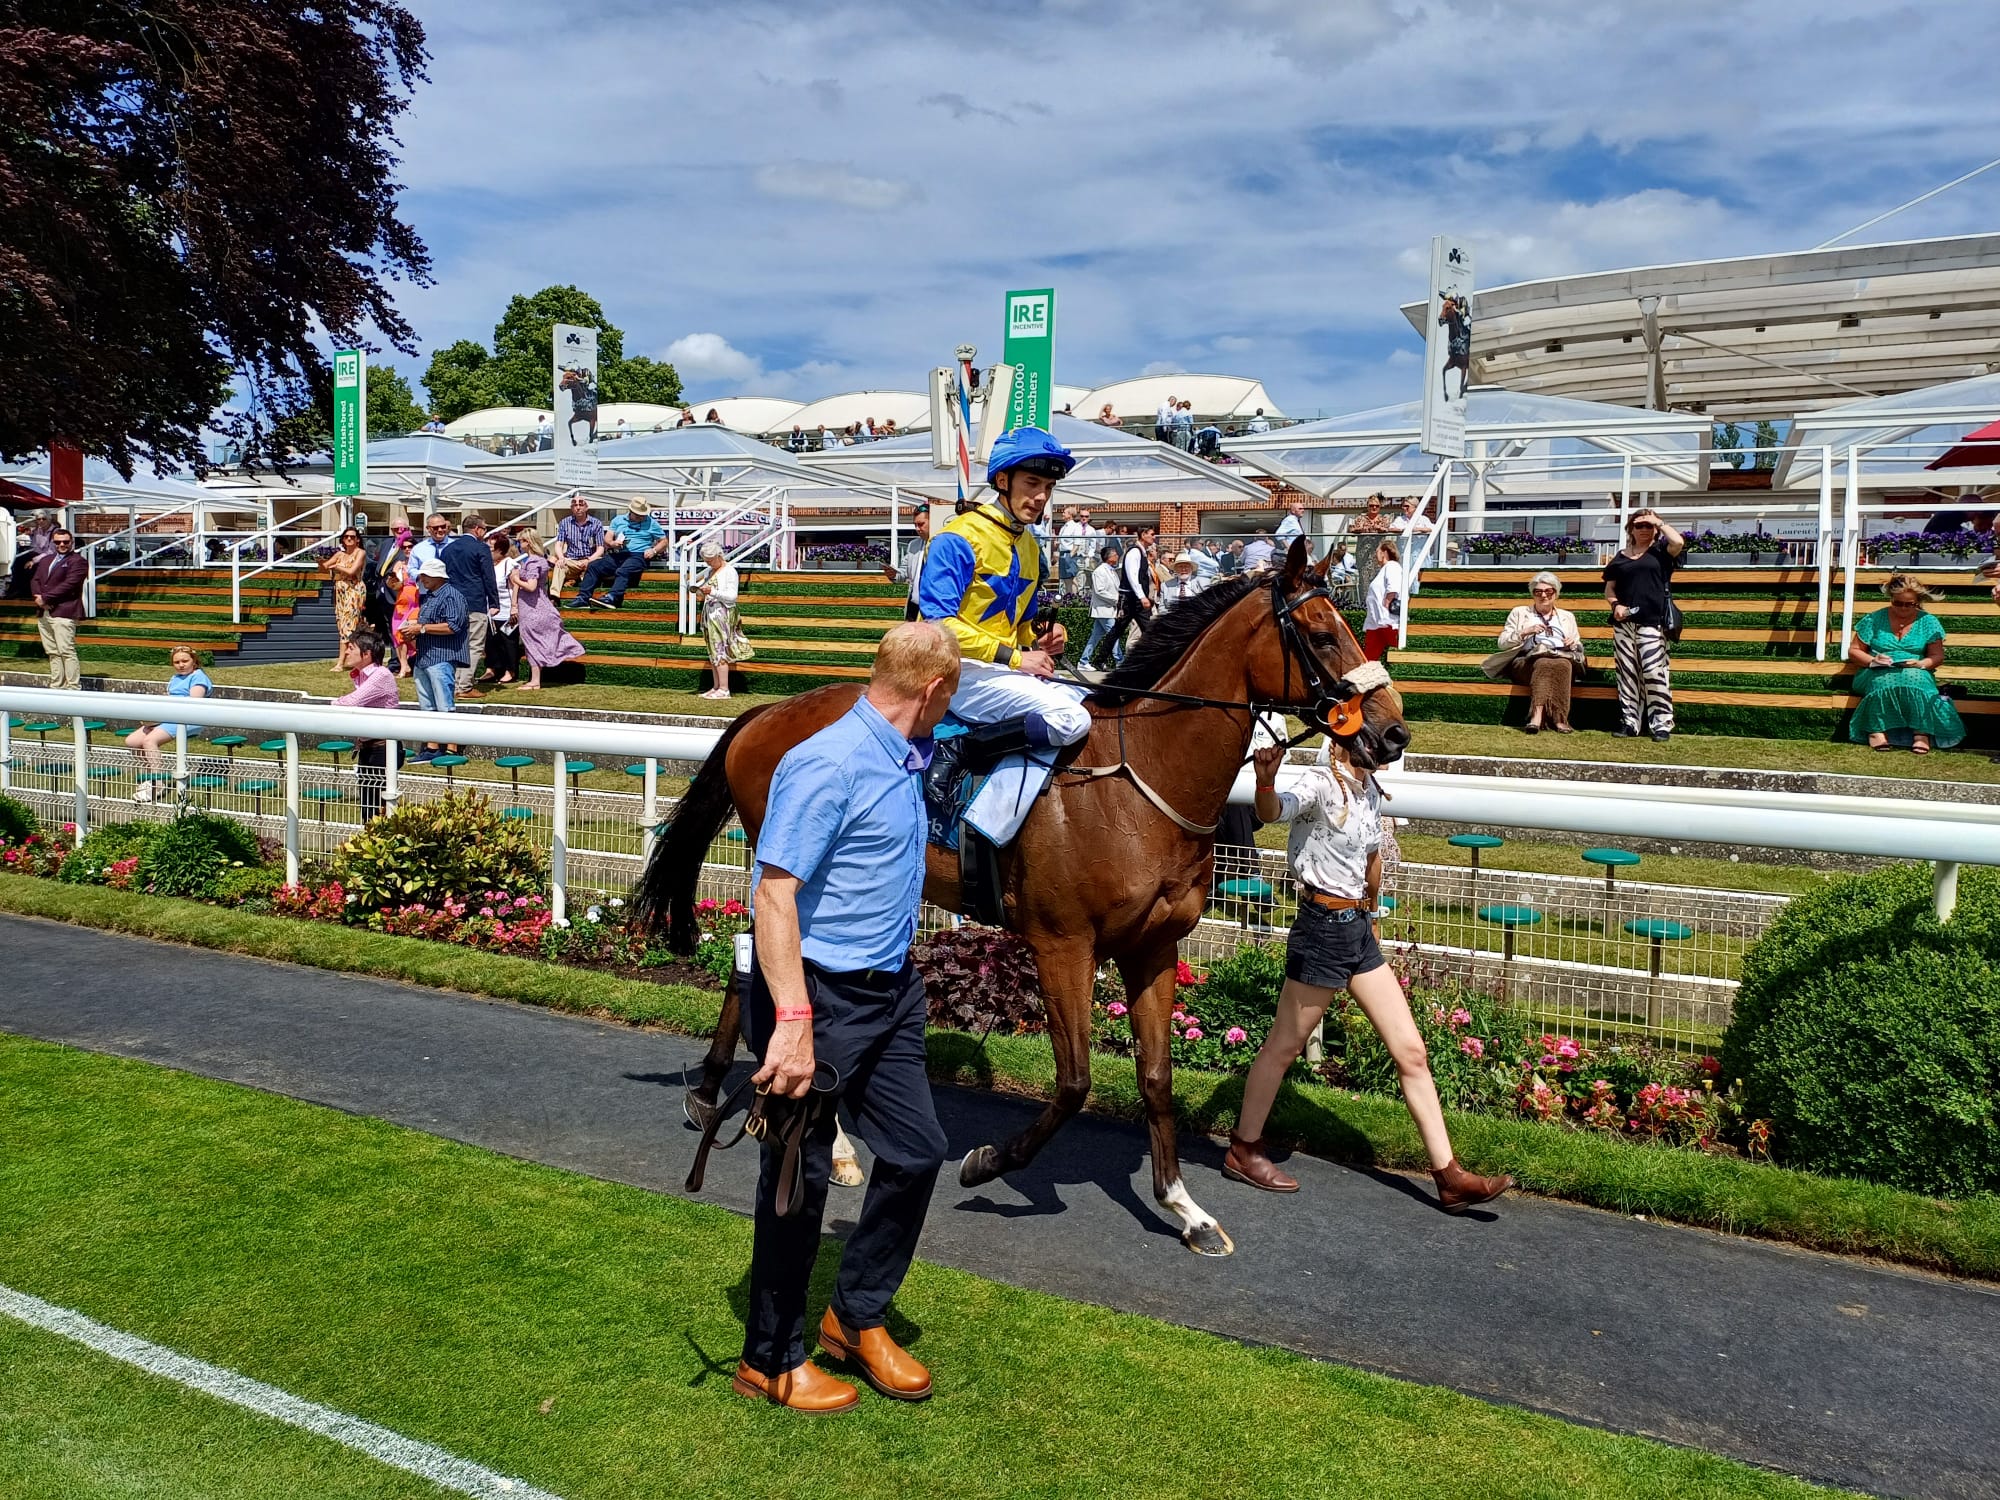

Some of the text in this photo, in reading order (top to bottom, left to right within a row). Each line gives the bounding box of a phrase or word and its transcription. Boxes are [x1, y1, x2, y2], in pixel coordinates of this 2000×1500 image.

[1013, 303, 1044, 322] IRE
[338, 361, 355, 376] IRE
[1014, 362, 1025, 411] €10,000
[348, 453, 354, 463] at
